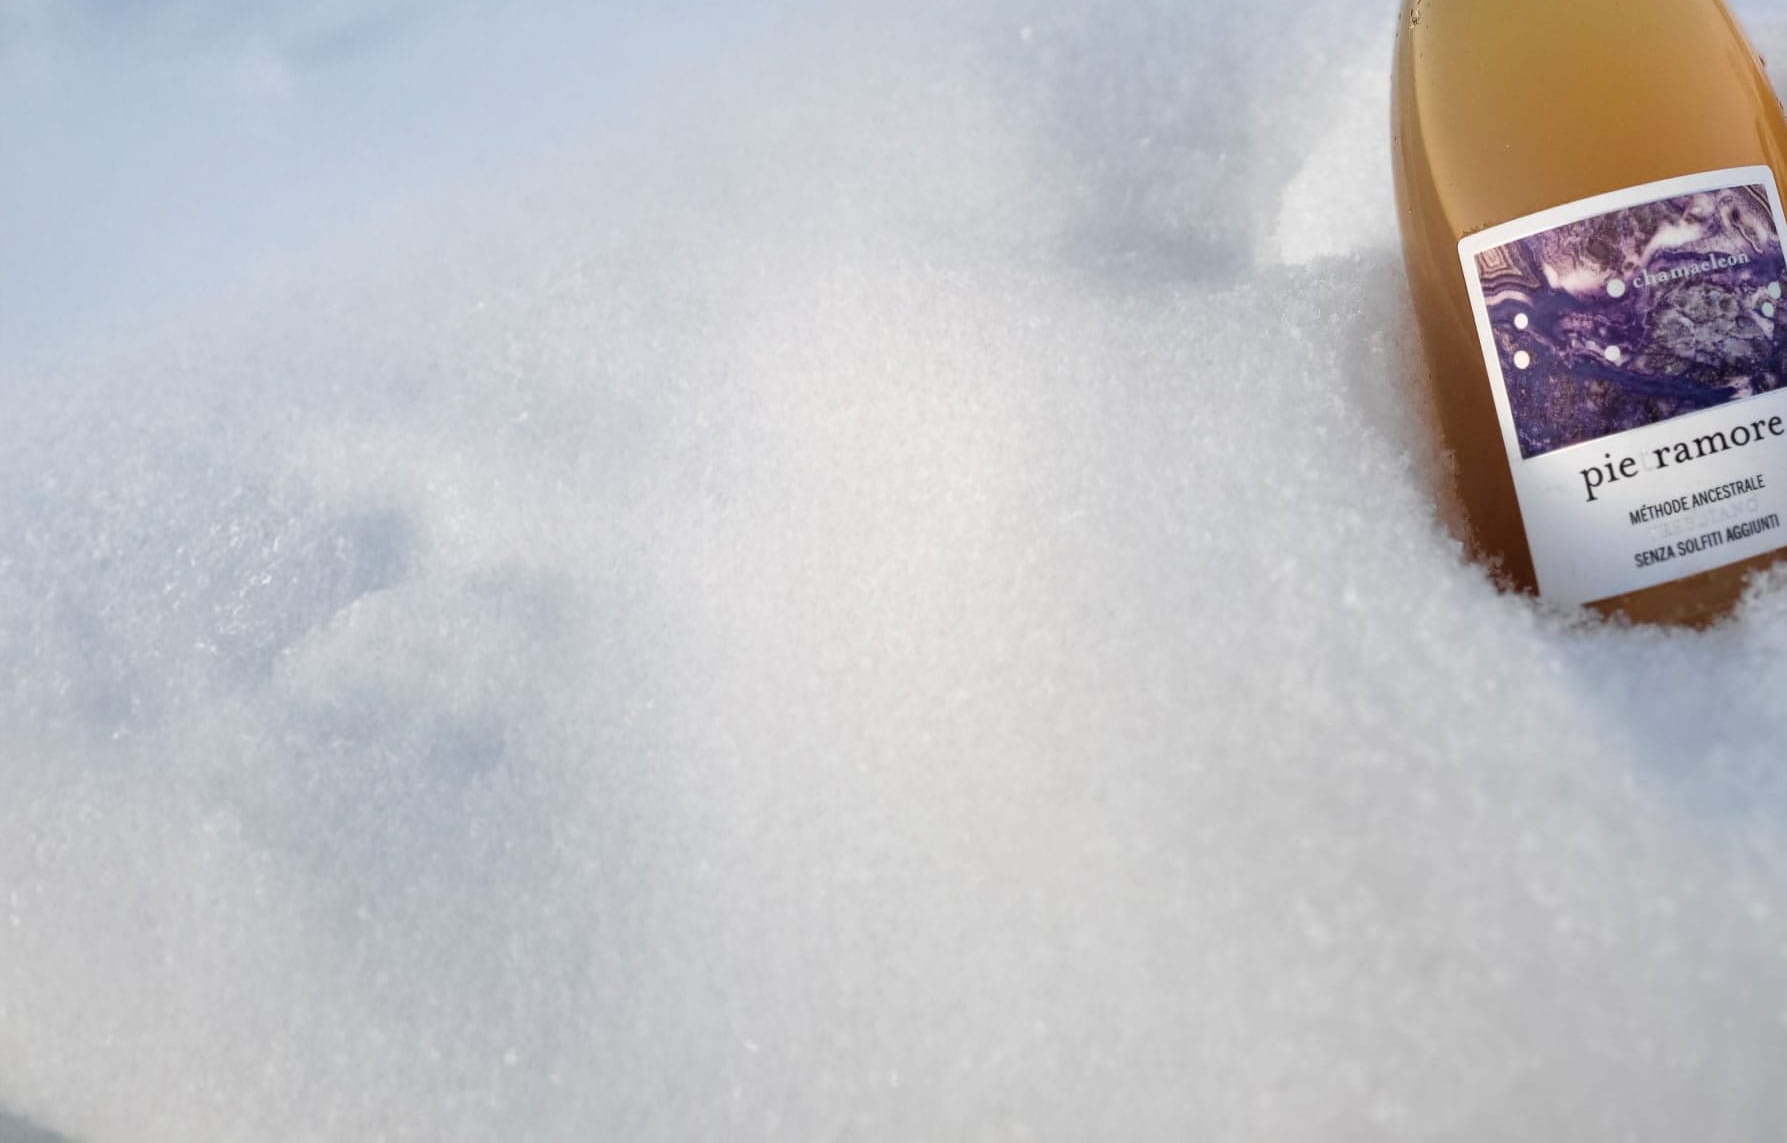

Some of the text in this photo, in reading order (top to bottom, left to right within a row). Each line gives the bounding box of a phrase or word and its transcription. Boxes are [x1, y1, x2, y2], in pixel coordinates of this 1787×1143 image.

[1632, 253, 1750, 289] chamaeleon
[1628, 474, 1766, 526] MÉTHODE ANCESTRALE
[1634, 513, 1780, 569] SENZA SOLFITI AGGIUNTI
